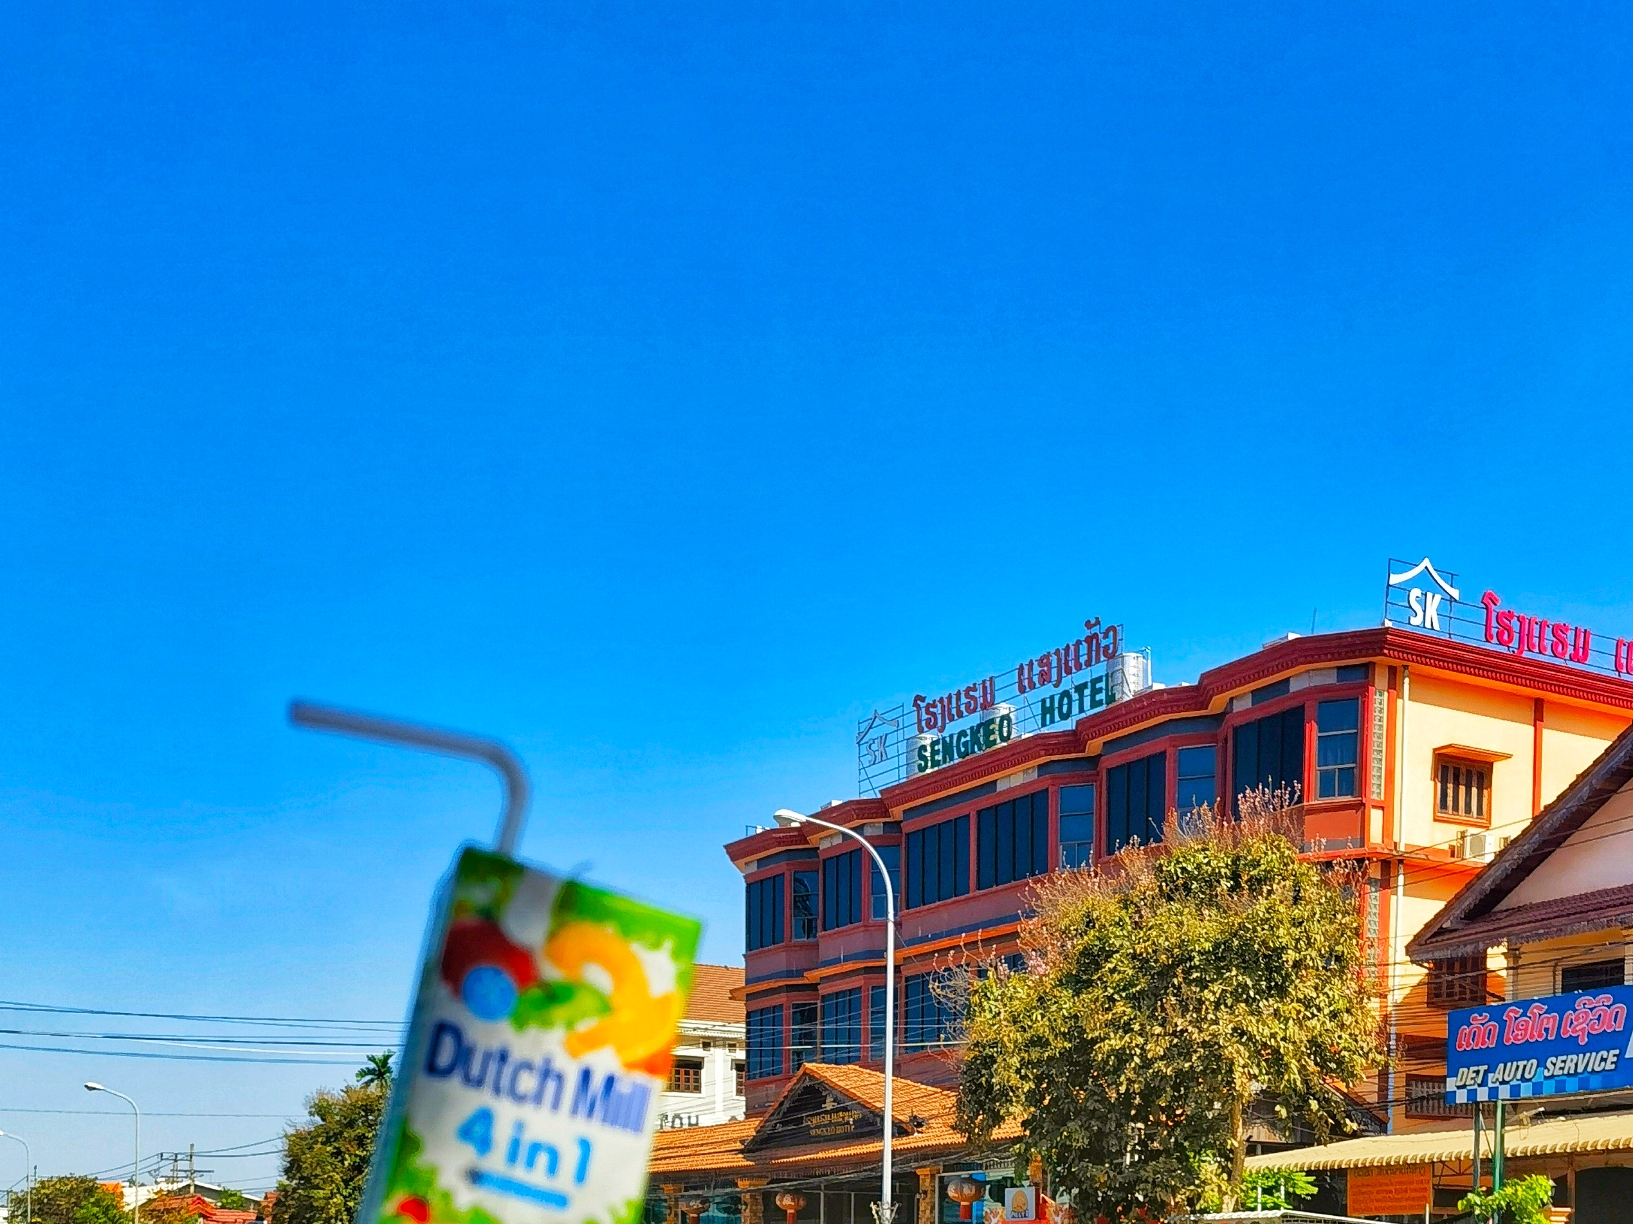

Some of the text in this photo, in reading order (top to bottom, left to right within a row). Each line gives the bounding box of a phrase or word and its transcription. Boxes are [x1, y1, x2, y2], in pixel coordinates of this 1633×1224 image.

[1408, 588, 1442, 631] SK
[1481, 590, 1591, 664] ໂຮງແຮມ
[913, 676, 995, 734] ໂຮງແຮມ
[917, 672, 1117, 773] SENGKEO HOTEL
[426, 1019, 565, 1112] Dutch
[1455, 1049, 1620, 1087] DET AUTO SERVICE
[456, 1105, 494, 1158] 4
[507, 1120, 559, 1178] in
